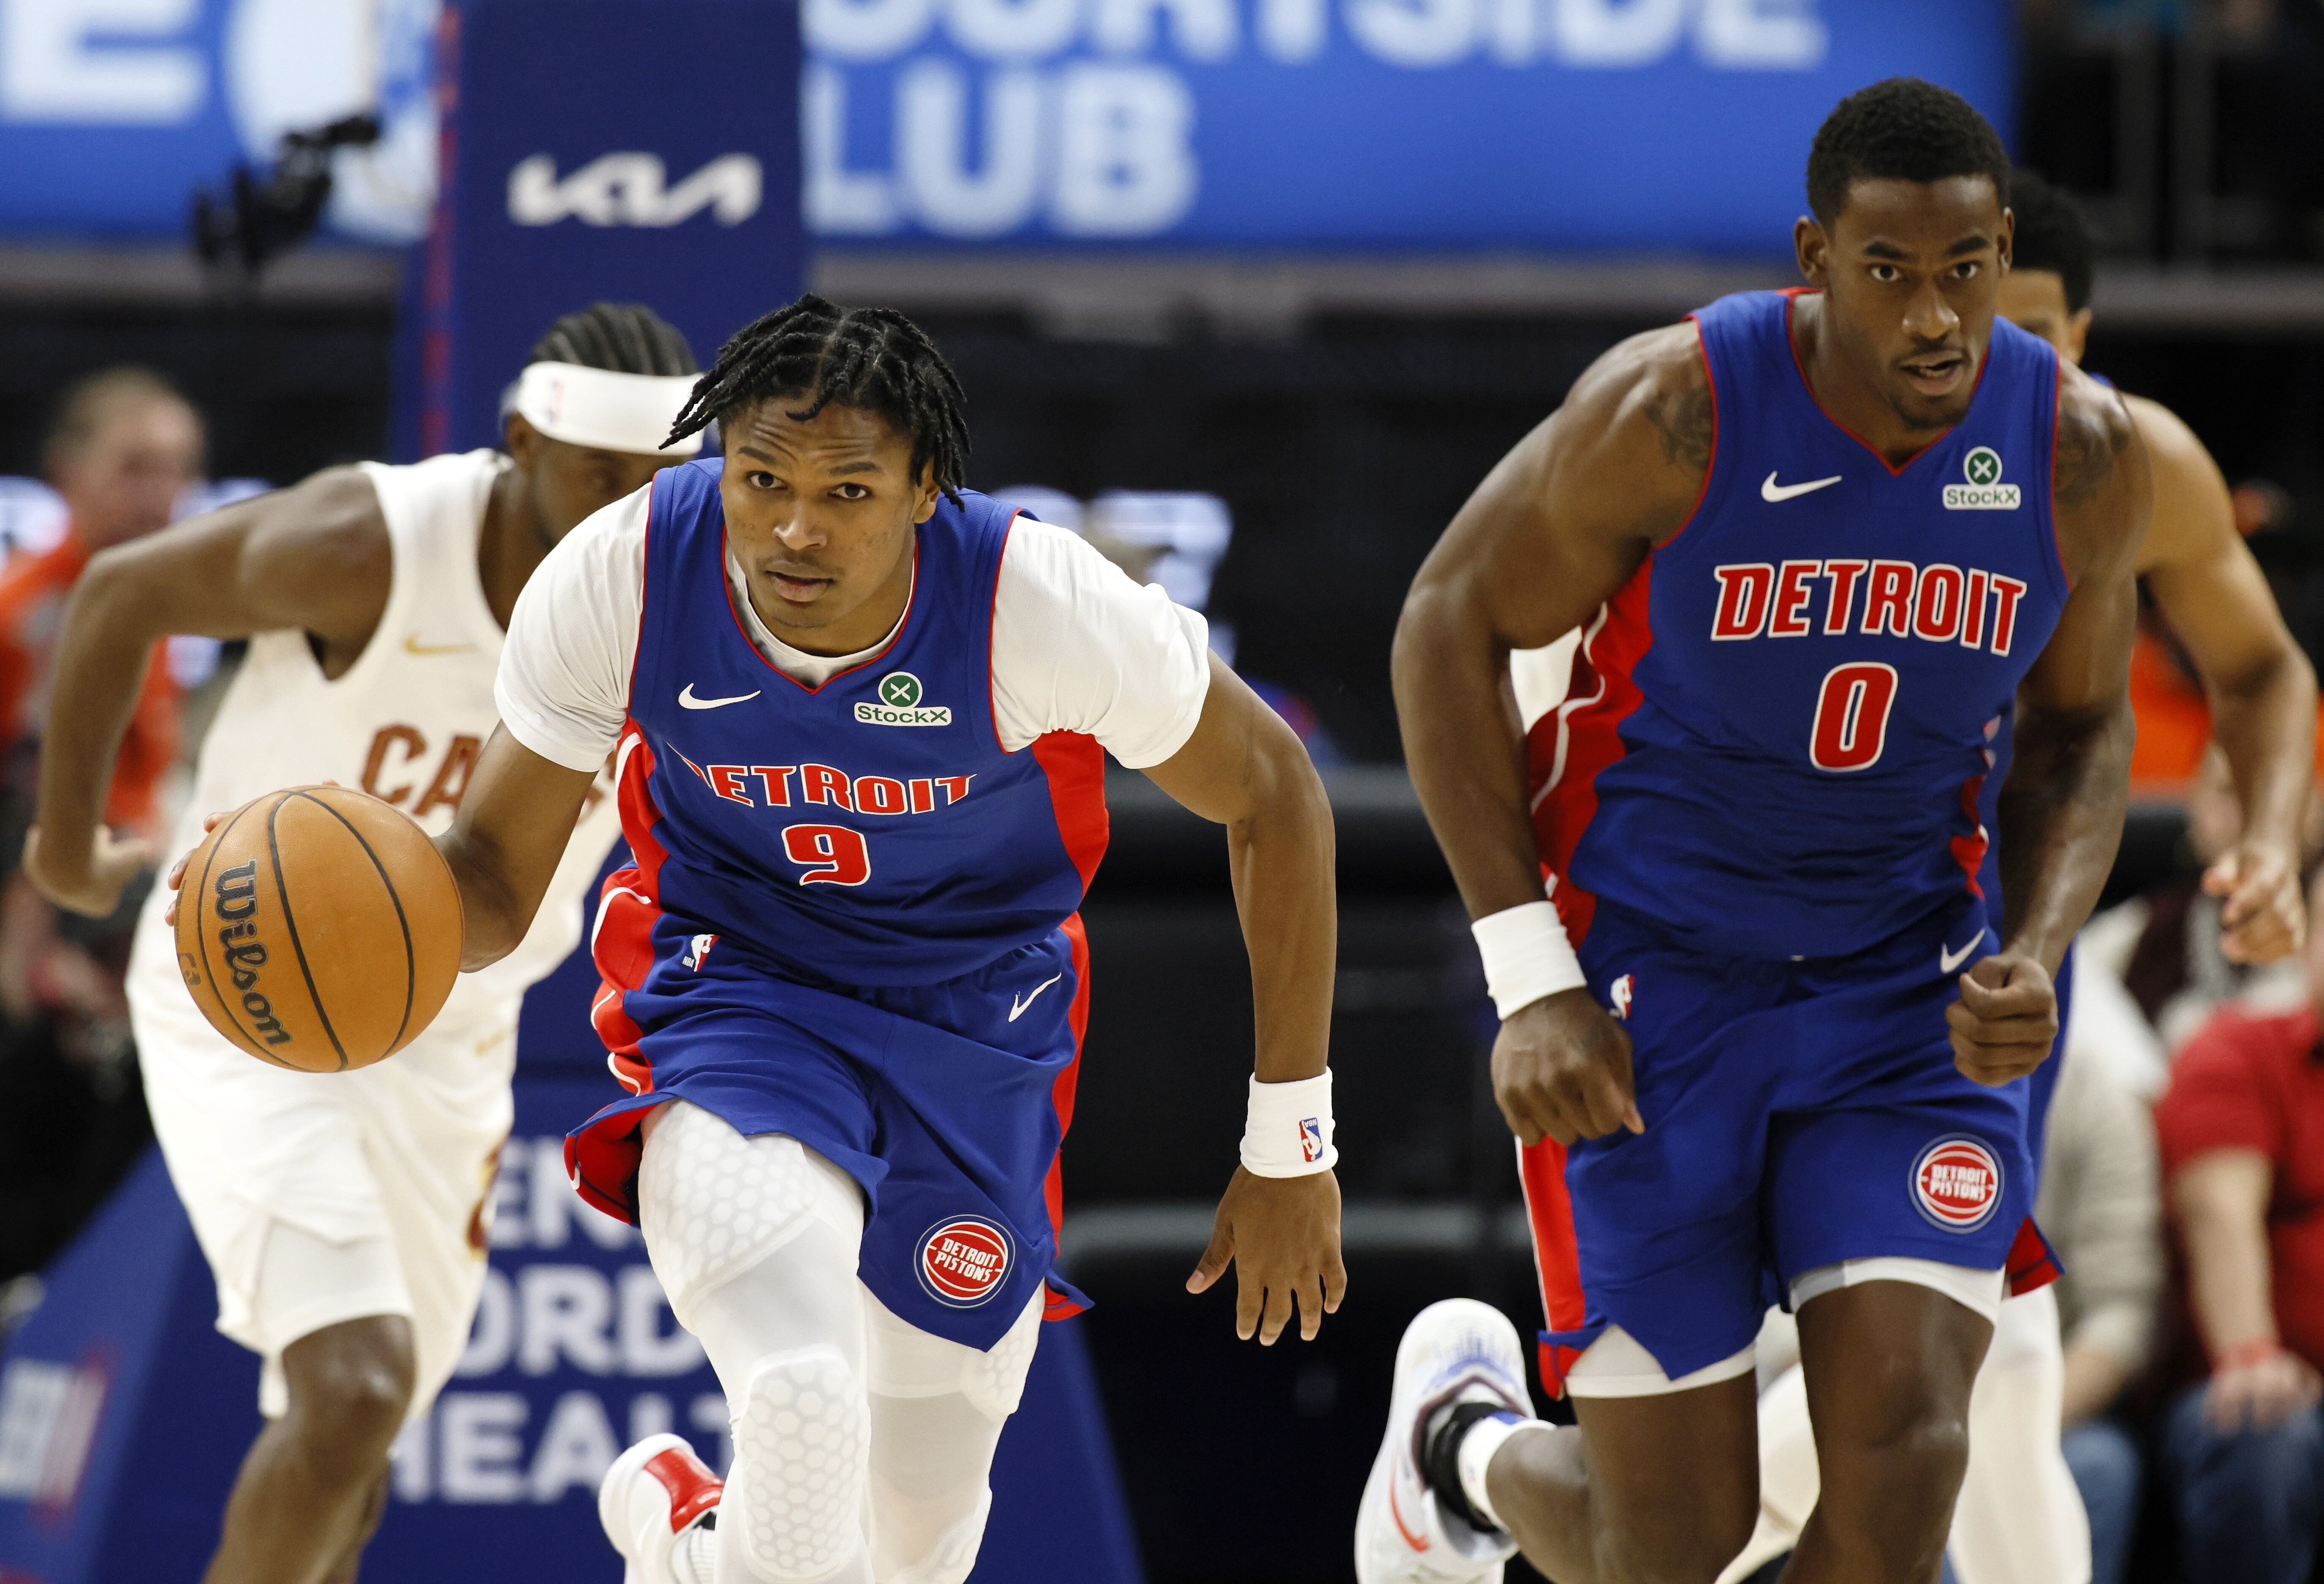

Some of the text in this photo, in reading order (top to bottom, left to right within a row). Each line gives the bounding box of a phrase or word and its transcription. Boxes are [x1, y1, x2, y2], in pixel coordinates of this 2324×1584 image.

[1947, 488, 2016, 505] StockX
[1711, 559, 2027, 657] DETROIT
[858, 705, 948, 723] StockX
[1809, 661, 1898, 773] 0
[666, 741, 977, 815] ETROIT
[780, 824, 871, 886] 9
[215, 858, 293, 1047] Wilson
[682, 955, 695, 968] NBA
[1304, 1119, 1317, 1128] NBA
[1931, 1163, 1988, 1184] DETROIT
[1929, 1180, 1986, 1202] PISTONS
[934, 1250, 993, 1283] PISTONS
[941, 1238, 999, 1268] DETROIT
